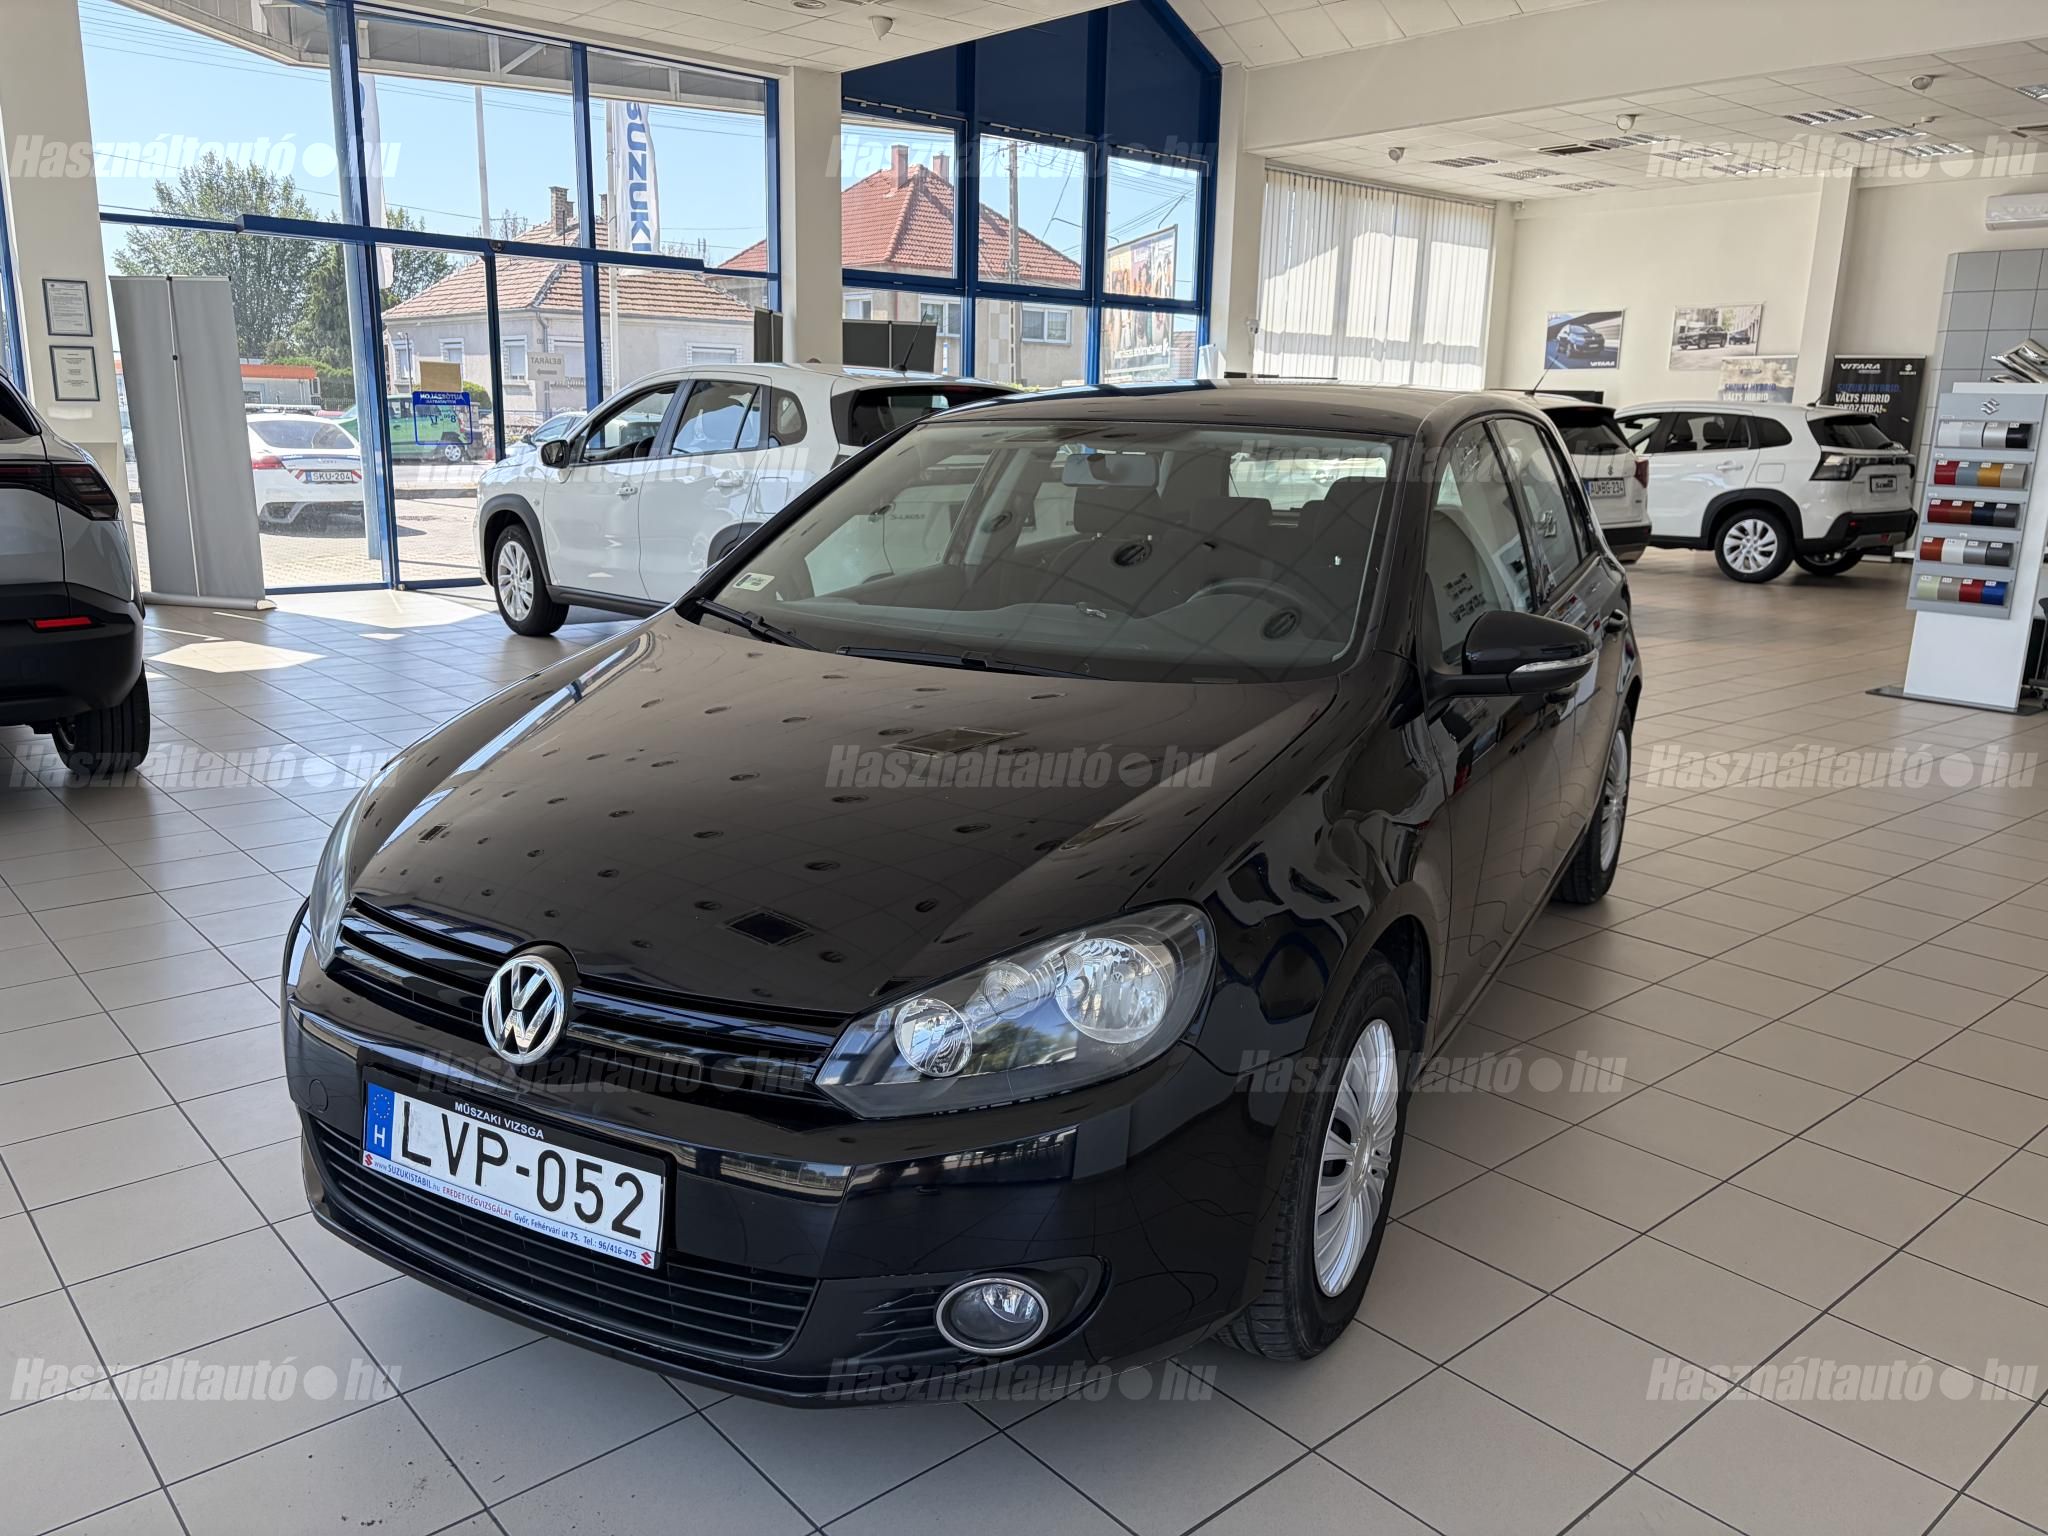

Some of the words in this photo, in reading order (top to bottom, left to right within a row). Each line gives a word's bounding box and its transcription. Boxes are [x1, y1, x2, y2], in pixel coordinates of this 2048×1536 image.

[626, 102, 652, 252] SUZUKI
[1861, 393, 1891, 404] HIBRID
[374, 1124, 386, 1148] H
[455, 1102, 501, 1125] MŰSZAKI
[504, 1118, 544, 1140] VIZSGA
[401, 1101, 644, 1239] LVP-052
